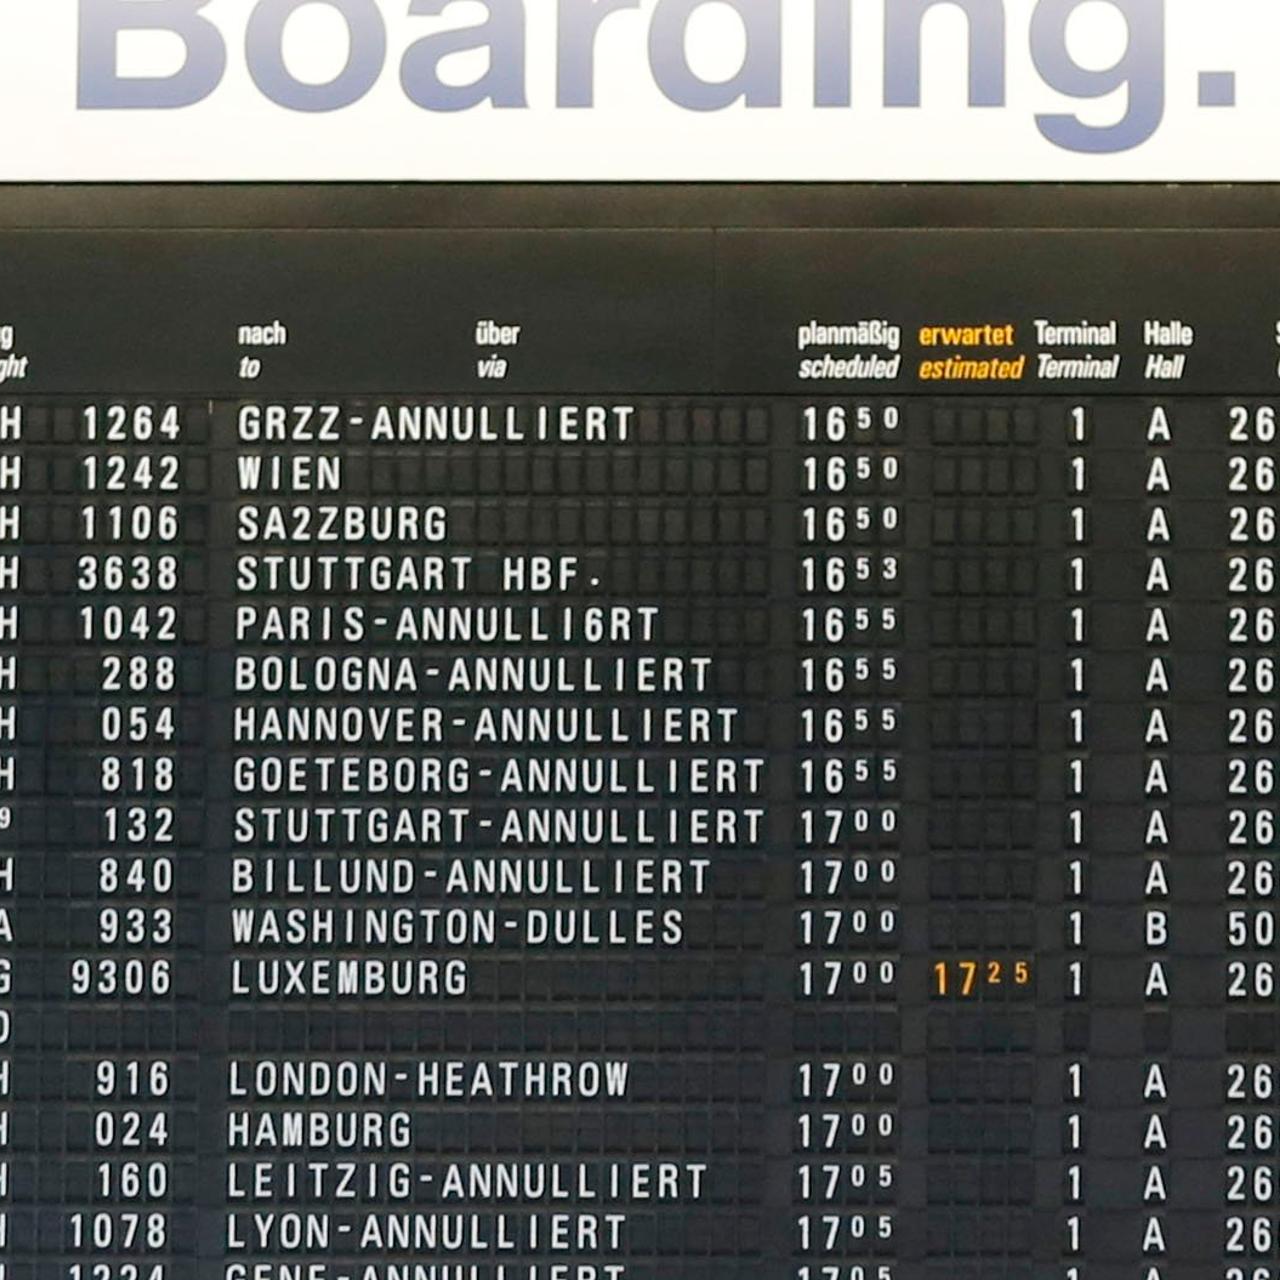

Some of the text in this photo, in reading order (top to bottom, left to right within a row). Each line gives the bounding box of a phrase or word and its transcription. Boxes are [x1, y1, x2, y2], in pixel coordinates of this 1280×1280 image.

[238, 320, 286, 346] nach
[476, 320, 520, 346] über
[798, 320, 901, 351] planmäßig
[918, 323, 1015, 347] erwartet
[1034, 320, 1117, 346] Terminal
[1144, 320, 1193, 346] Halle
[239, 355, 261, 379] to
[478, 354, 508, 379] via
[798, 354, 900, 380] scheduled
[918, 354, 1026, 380] estimated
[1038, 353, 1120, 379] Terminal
[1145, 354, 1186, 379] Hall
[239, 406, 633, 440] GRZZ-ANNULLIERT
[238, 456, 339, 489] WIEN
[238, 556, 598, 590] STUTTGART HBF.
[236, 656, 711, 691] BOLOGNA-ANNULLIERT
[235, 708, 737, 742] HANNOVER-ANNULLIERT
[235, 757, 763, 792] GOETEBORG-ANNULLIERT
[235, 808, 763, 843] STUTTGART-ANNULLIERT
[233, 859, 710, 893] BILLUND-ANNULLIERT
[233, 909, 681, 944] WASHINGTON-DULLES
[233, 960, 465, 994] LUXEMBURG
[231, 1061, 627, 1096] LONDON-HEATHROW
[229, 1113, 409, 1146] HAMBURG
[229, 1163, 706, 1198] LEITZIG-ANNULLIERT
[229, 1214, 625, 1249] LYON-ANNULLIERT
